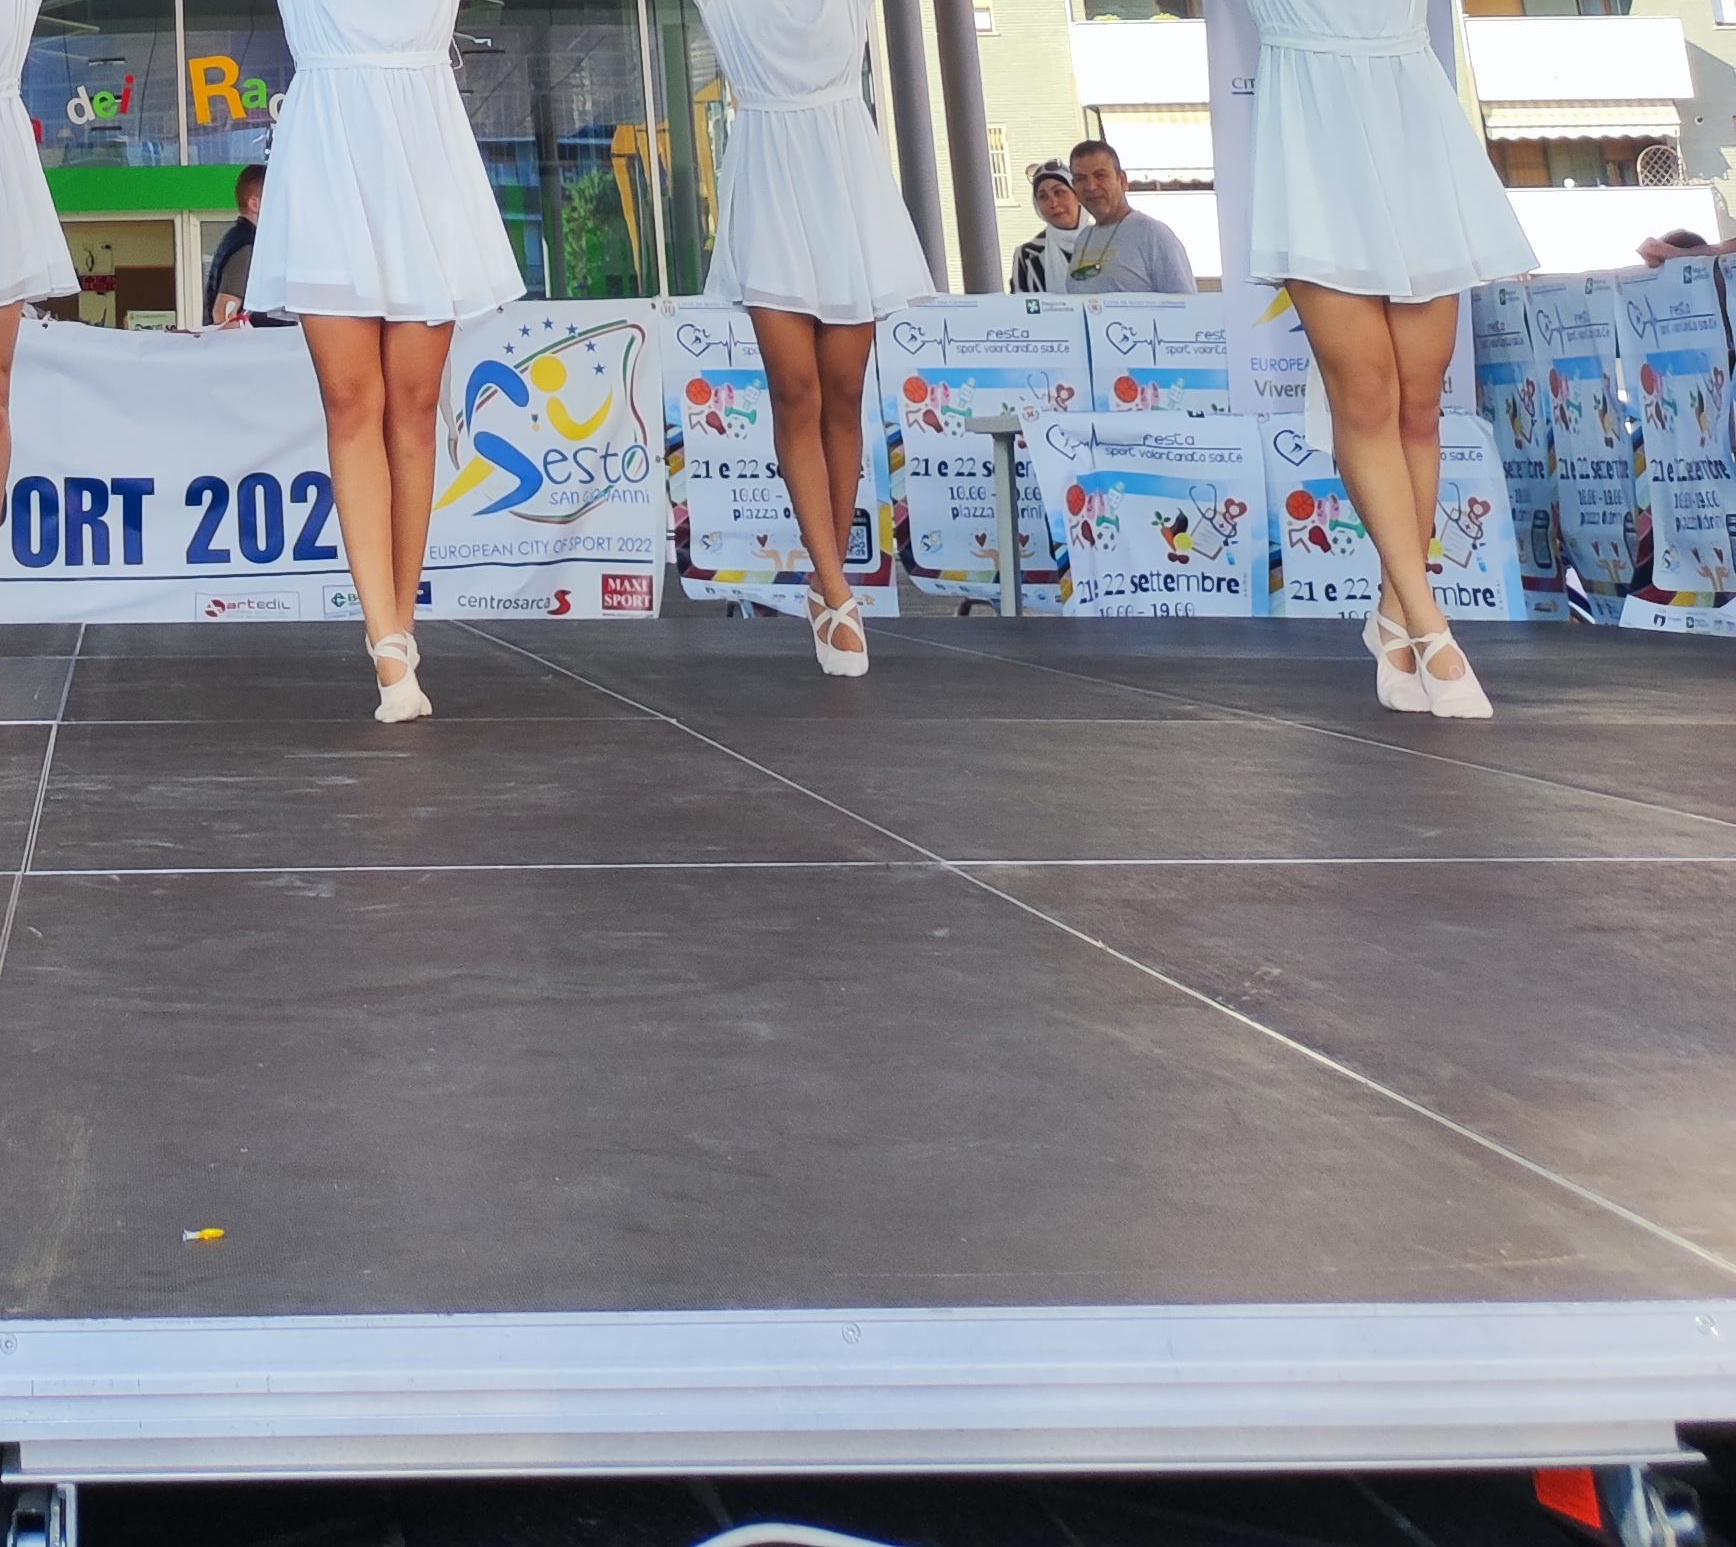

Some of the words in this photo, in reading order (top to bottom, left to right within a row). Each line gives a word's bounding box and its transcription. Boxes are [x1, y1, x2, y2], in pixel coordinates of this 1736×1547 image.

[67, 74, 135, 125] dei
[690, 459, 713, 480] 21
[719, 462, 731, 479] e
[736, 459, 760, 479] 22
[909, 457, 931, 477] 21
[937, 460, 949, 477] e
[954, 457, 977, 477] 22
[185, 470, 339, 565] 202
[733, 507, 779, 521] piazza
[951, 506, 995, 520] piazza
[429, 542, 513, 560] EUROPEAN
[517, 539, 550, 556] CITY
[568, 536, 612, 552] SPORT
[617, 537, 652, 554] 2022
[606, 577, 649, 592] MAXI
[1103, 573, 1126, 596] 22
[1130, 569, 1240, 594] settembre
[1290, 579, 1318, 602] 21
[1324, 583, 1337, 601] e
[1343, 578, 1372, 600] 22
[604, 593, 651, 608] SPORT
